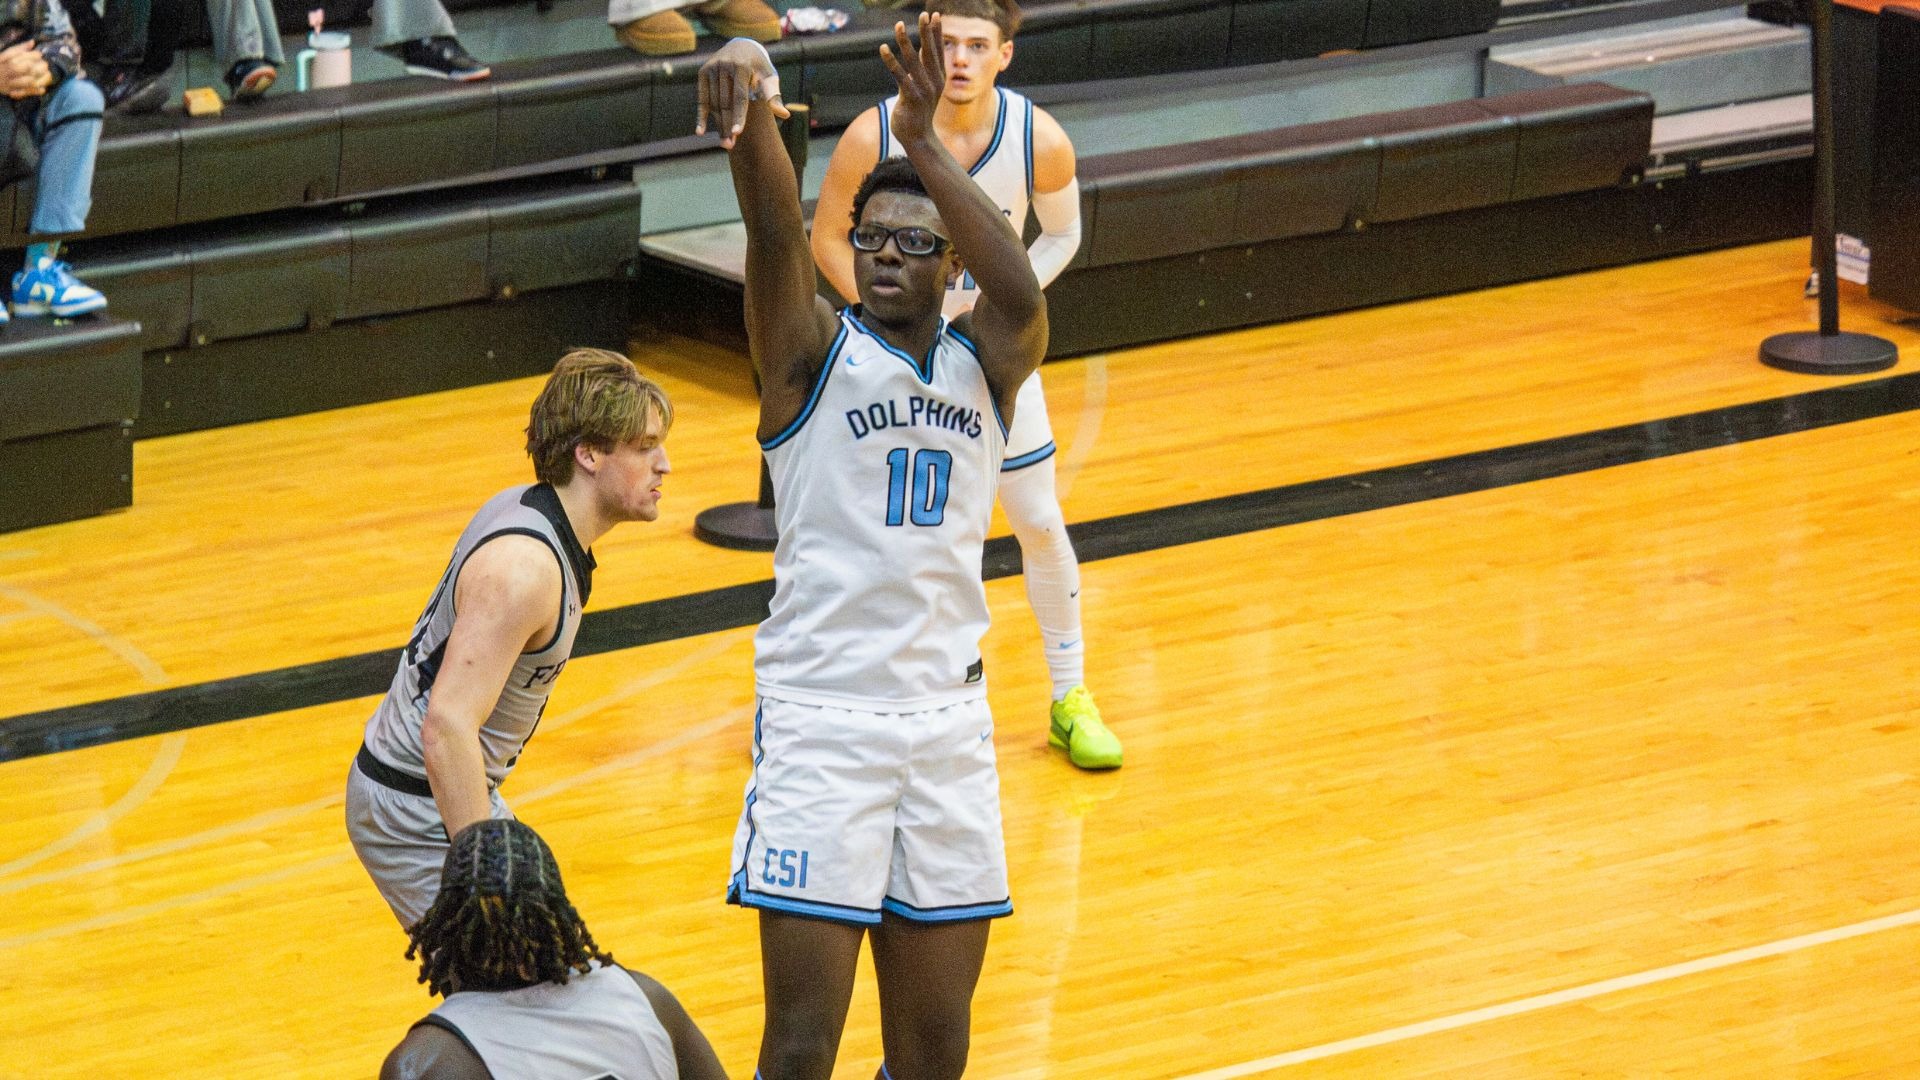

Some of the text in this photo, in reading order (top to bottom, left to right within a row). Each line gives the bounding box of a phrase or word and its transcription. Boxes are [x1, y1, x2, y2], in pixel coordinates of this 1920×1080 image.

[846, 396, 982, 439] DOLPHINS
[885, 447, 953, 527] 10
[763, 848, 809, 889] CSI
